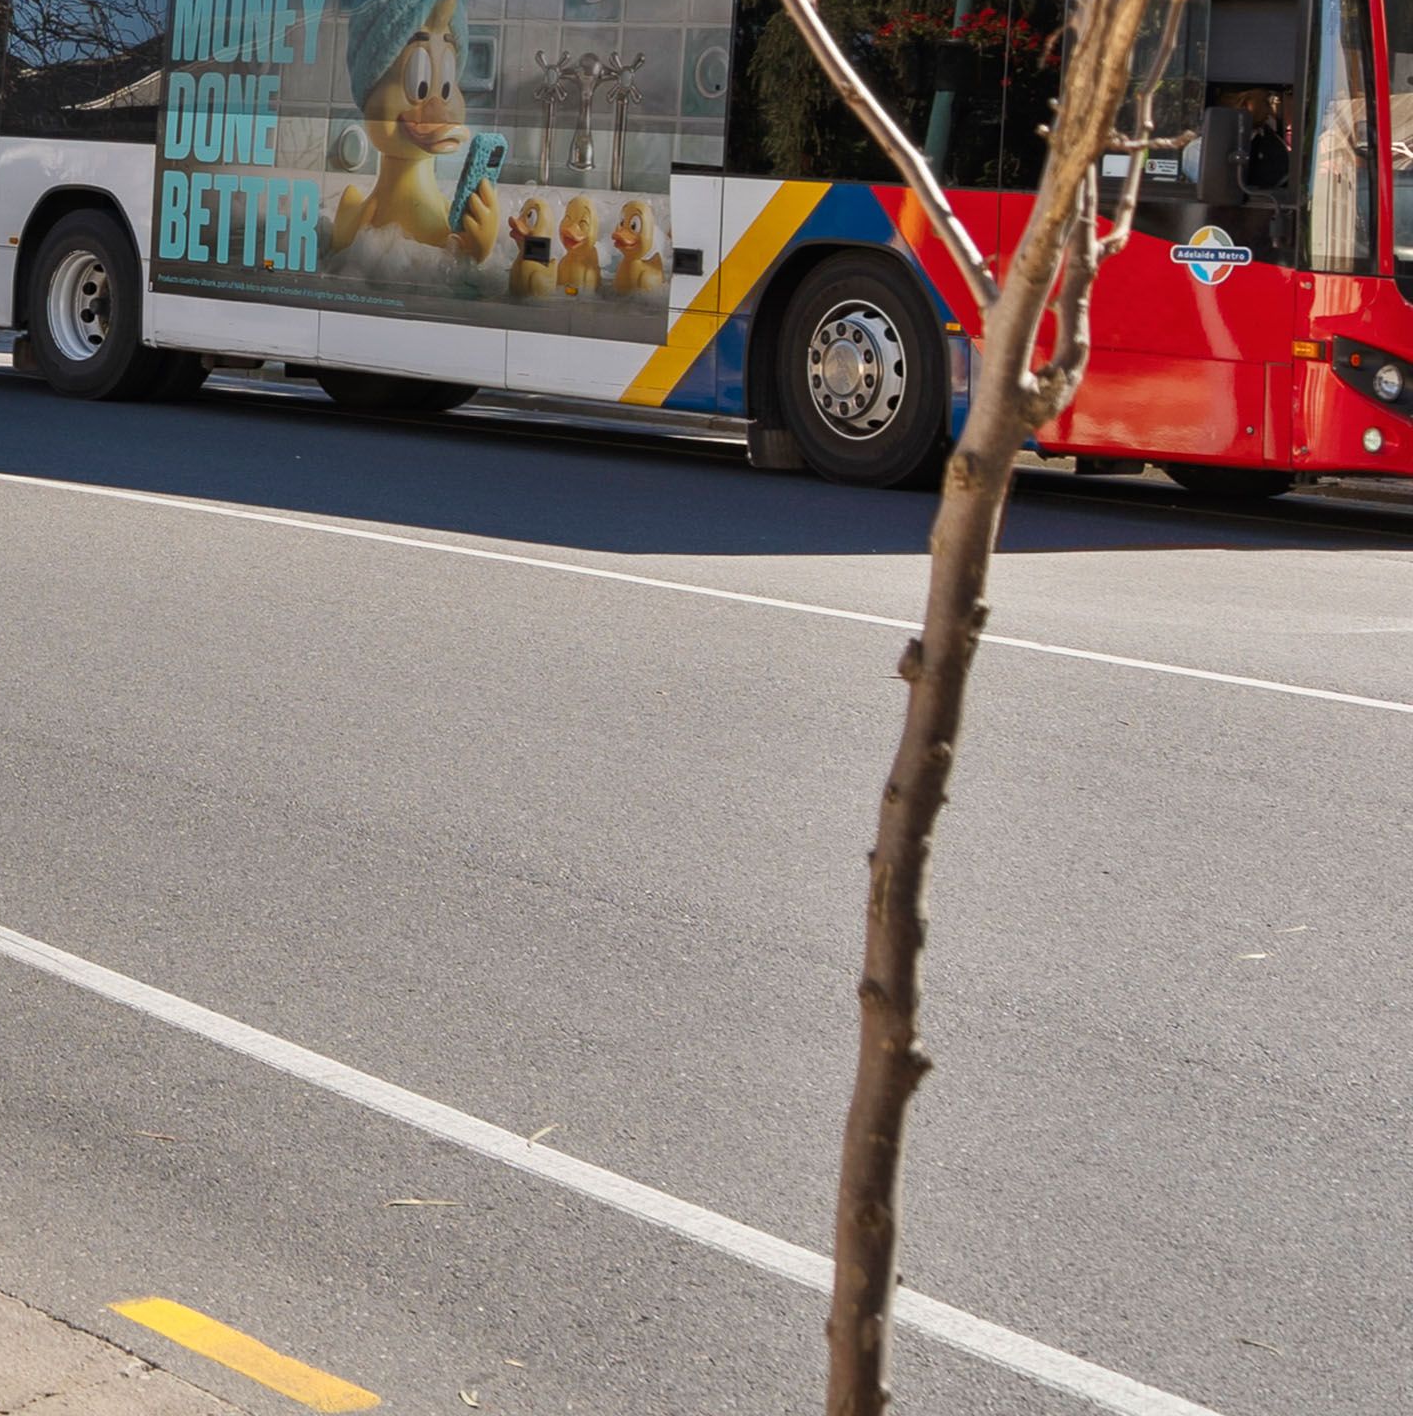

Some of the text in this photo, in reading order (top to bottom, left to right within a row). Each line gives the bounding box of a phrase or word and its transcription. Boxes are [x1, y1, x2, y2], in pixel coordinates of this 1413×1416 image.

[163, 71, 280, 166] DONE
[158, 169, 319, 275] BETTER
[1177, 249, 1246, 261] Adelaide Metro
